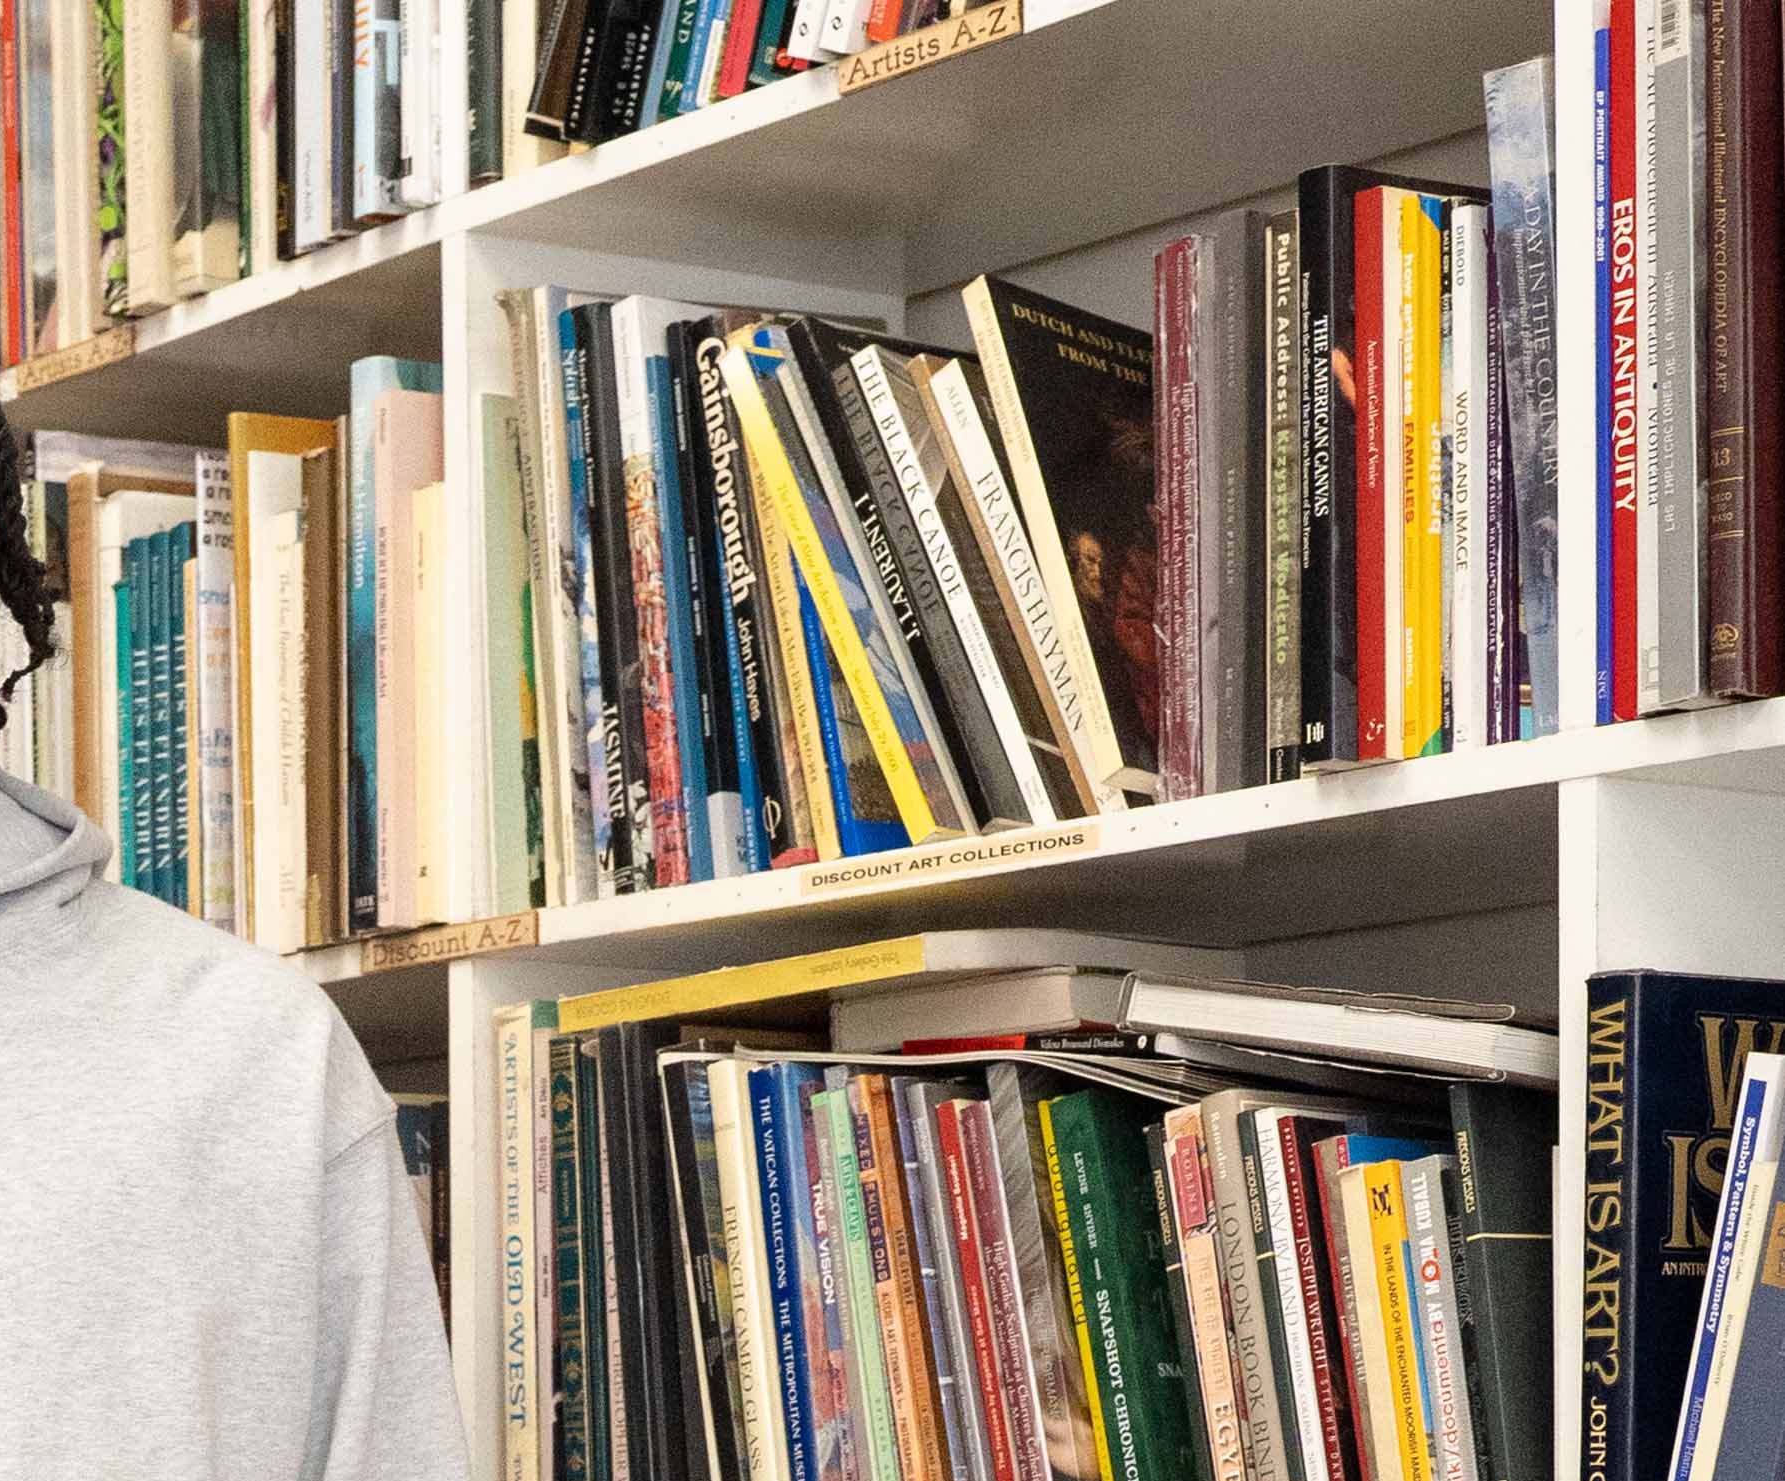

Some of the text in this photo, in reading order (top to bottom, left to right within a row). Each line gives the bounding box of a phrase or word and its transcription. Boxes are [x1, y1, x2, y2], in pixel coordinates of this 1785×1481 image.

[845, 7, 1008, 86] Artists A-Z
[1611, 197, 1636, 513] EROS IN ANTIQUITY
[1714, 207, 1727, 393] ENCYCLOPEDIA OF ART
[857, 354, 962, 602] THE BLACK CANOE
[1273, 232, 1291, 664] Public Address: Krzysztof Wodiczko
[1313, 314, 1329, 517] THE AMERICAN CANVAS
[694, 336, 763, 722] Gainsborough John Hayes
[810, 832, 1086, 889] DISCOUNT ART COLLECTIONS
[372, 922, 524, 966] Discount A-Z
[1210, 1110, 1229, 1180] Ramsden
[1587, 998, 1626, 1166] WHAT
[758, 1095, 788, 1289] THE VATICAN COLLECTIONS
[811, 1180, 836, 1305] TRUE VISION
[1586, 1178, 1622, 1234] IS
[1705, 1116, 1757, 1334] Symbol, Pattern & Symmetry
[778, 1299, 792, 1329] THE
[1073, 1150, 1089, 1196] LEVINE
[1081, 1203, 1099, 1249] SNYDER
[1095, 1288, 1124, 1390] SNAPSHOT
[1220, 1198, 1256, 1326] LONDON
[1296, 1238, 1329, 1370] JOSEPH WRIGHT
[1583, 1239, 1622, 1386] ART?
[724, 1205, 765, 1472] FRENCH CAMEO GLASS
[781, 1332, 801, 1440] METROPOLITAN
[1237, 1334, 1265, 1411] BOOK
[1589, 1395, 1608, 1466] JOHN
